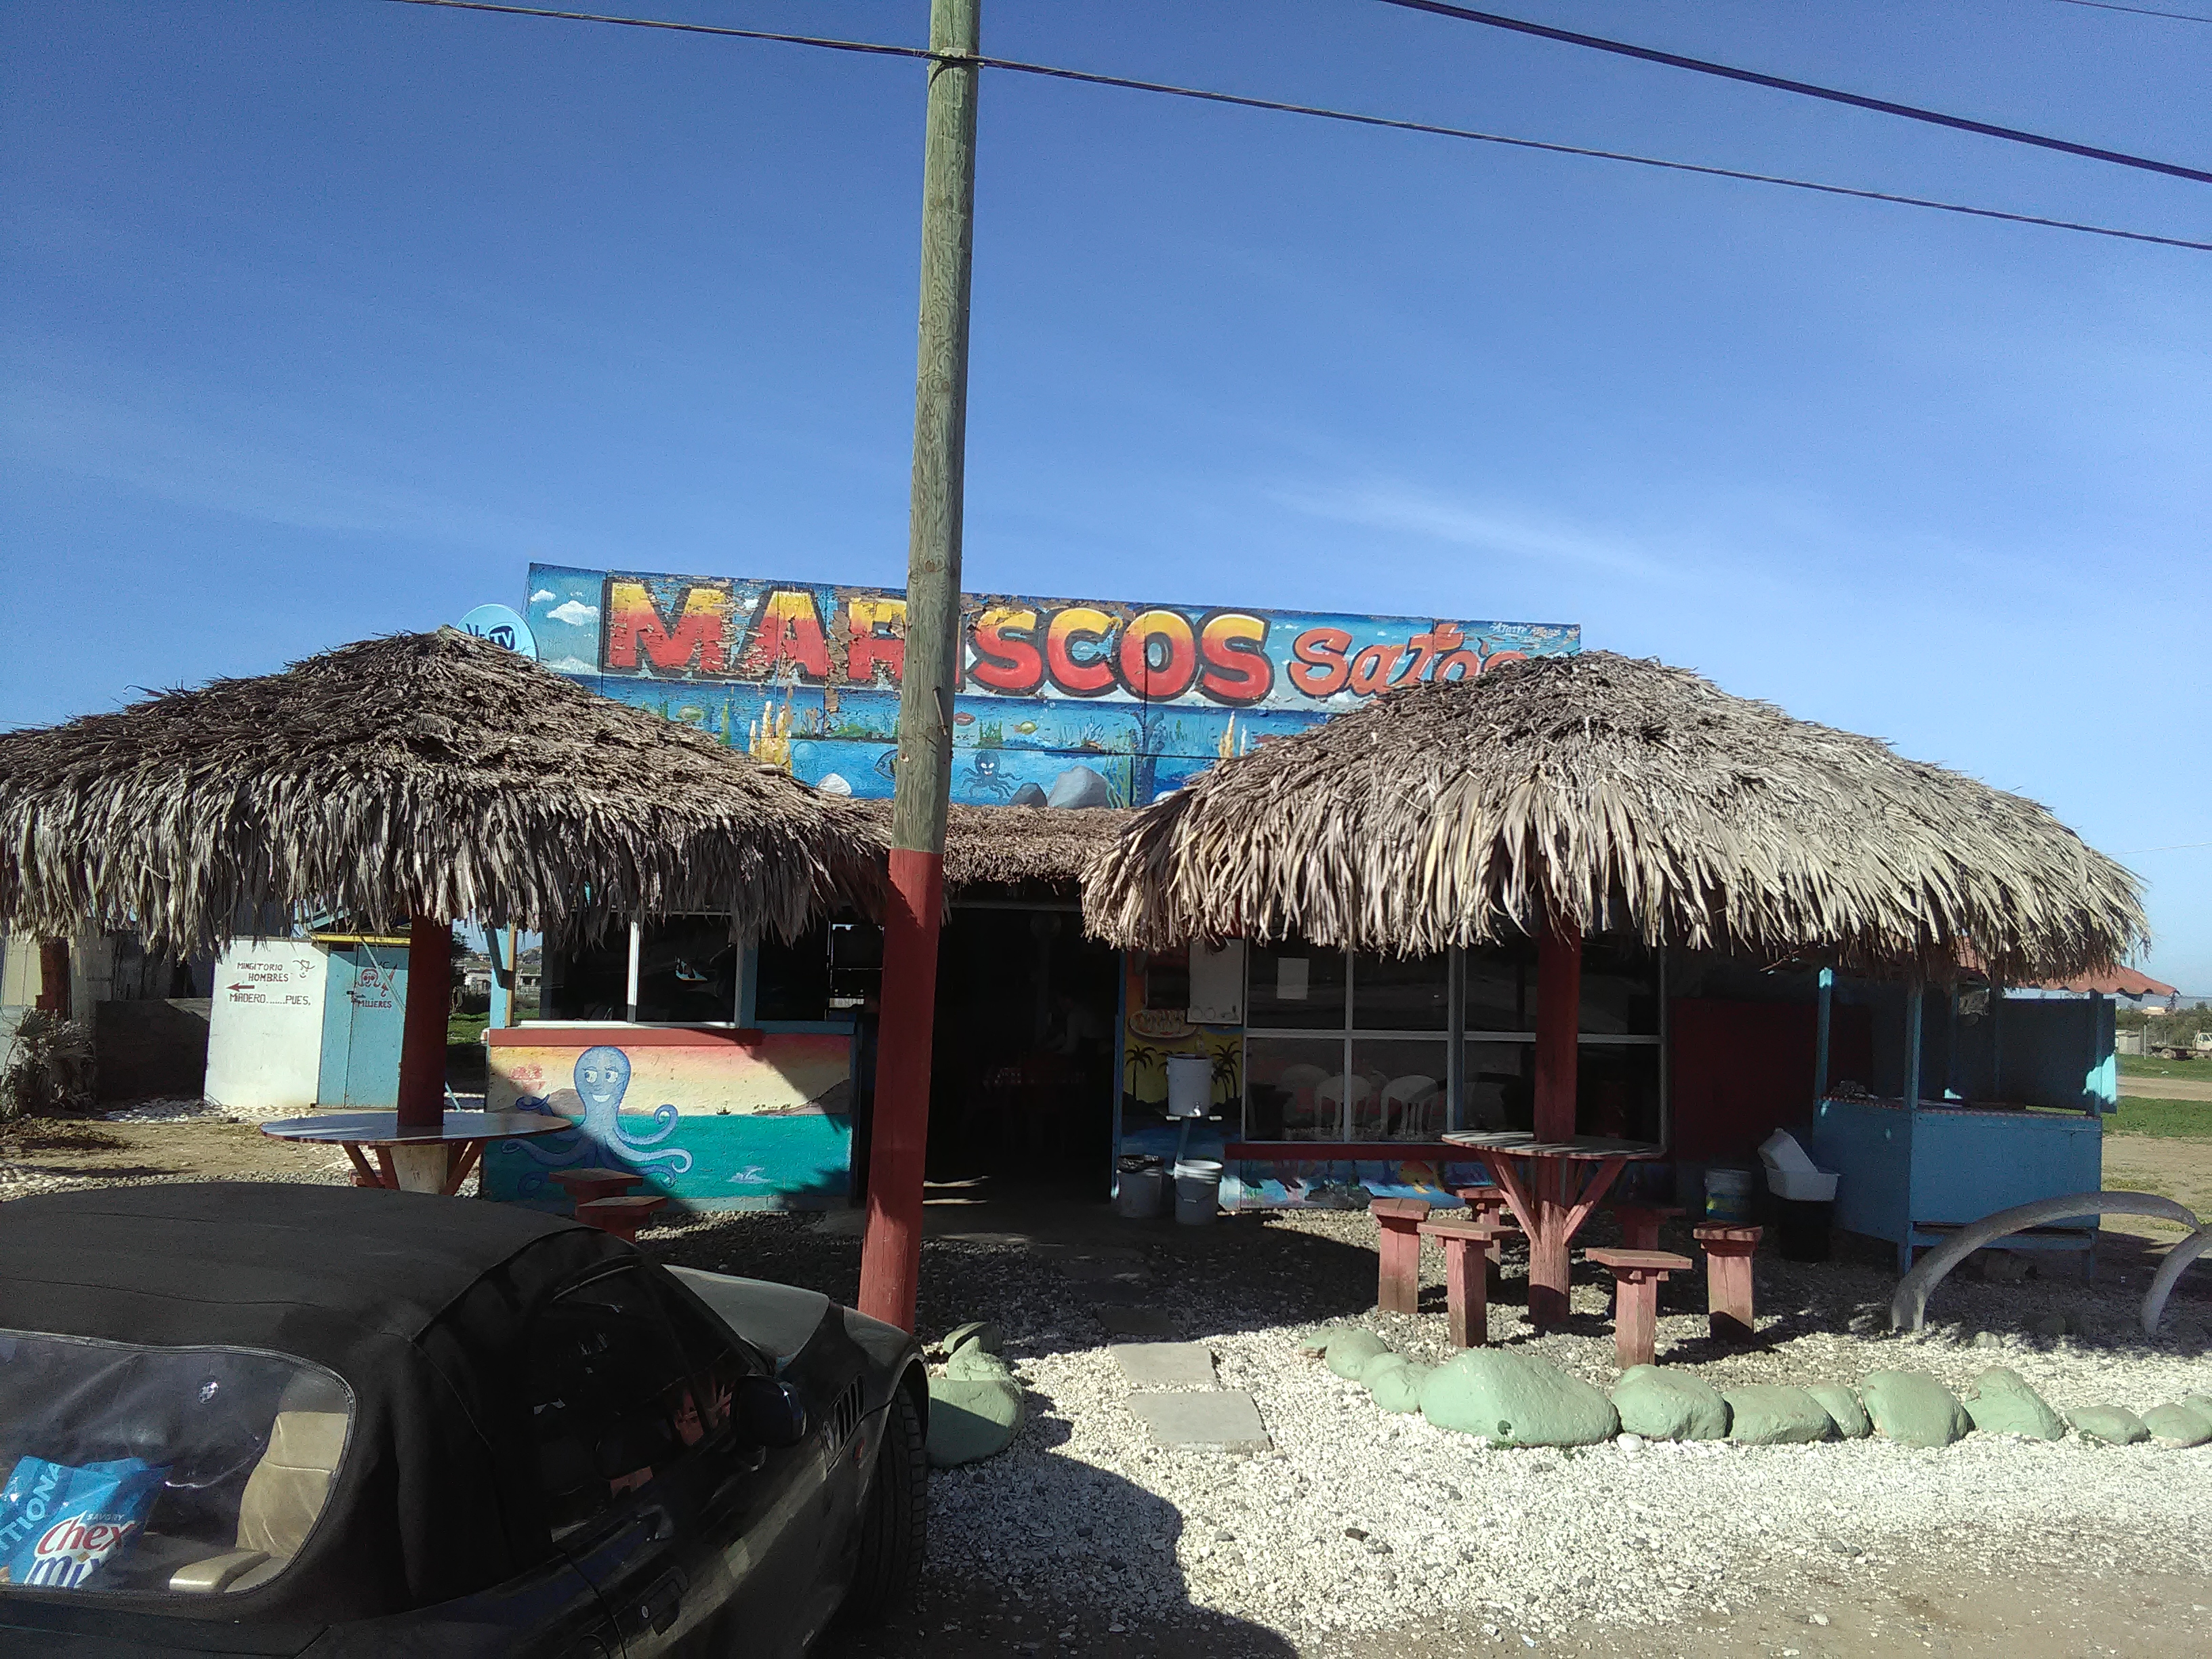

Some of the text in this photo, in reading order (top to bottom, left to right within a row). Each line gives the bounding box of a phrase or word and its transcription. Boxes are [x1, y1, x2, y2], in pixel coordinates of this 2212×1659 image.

[605, 579, 1271, 699] MARSCOS
[237, 962, 283, 971] MINGITORIO
[248, 972, 289, 982] HOMBRES
[357, 1000, 392, 1008] MUJERES
[87, 1513, 125, 1521] SAVORY
[37, 1519, 136, 1555] Chex
